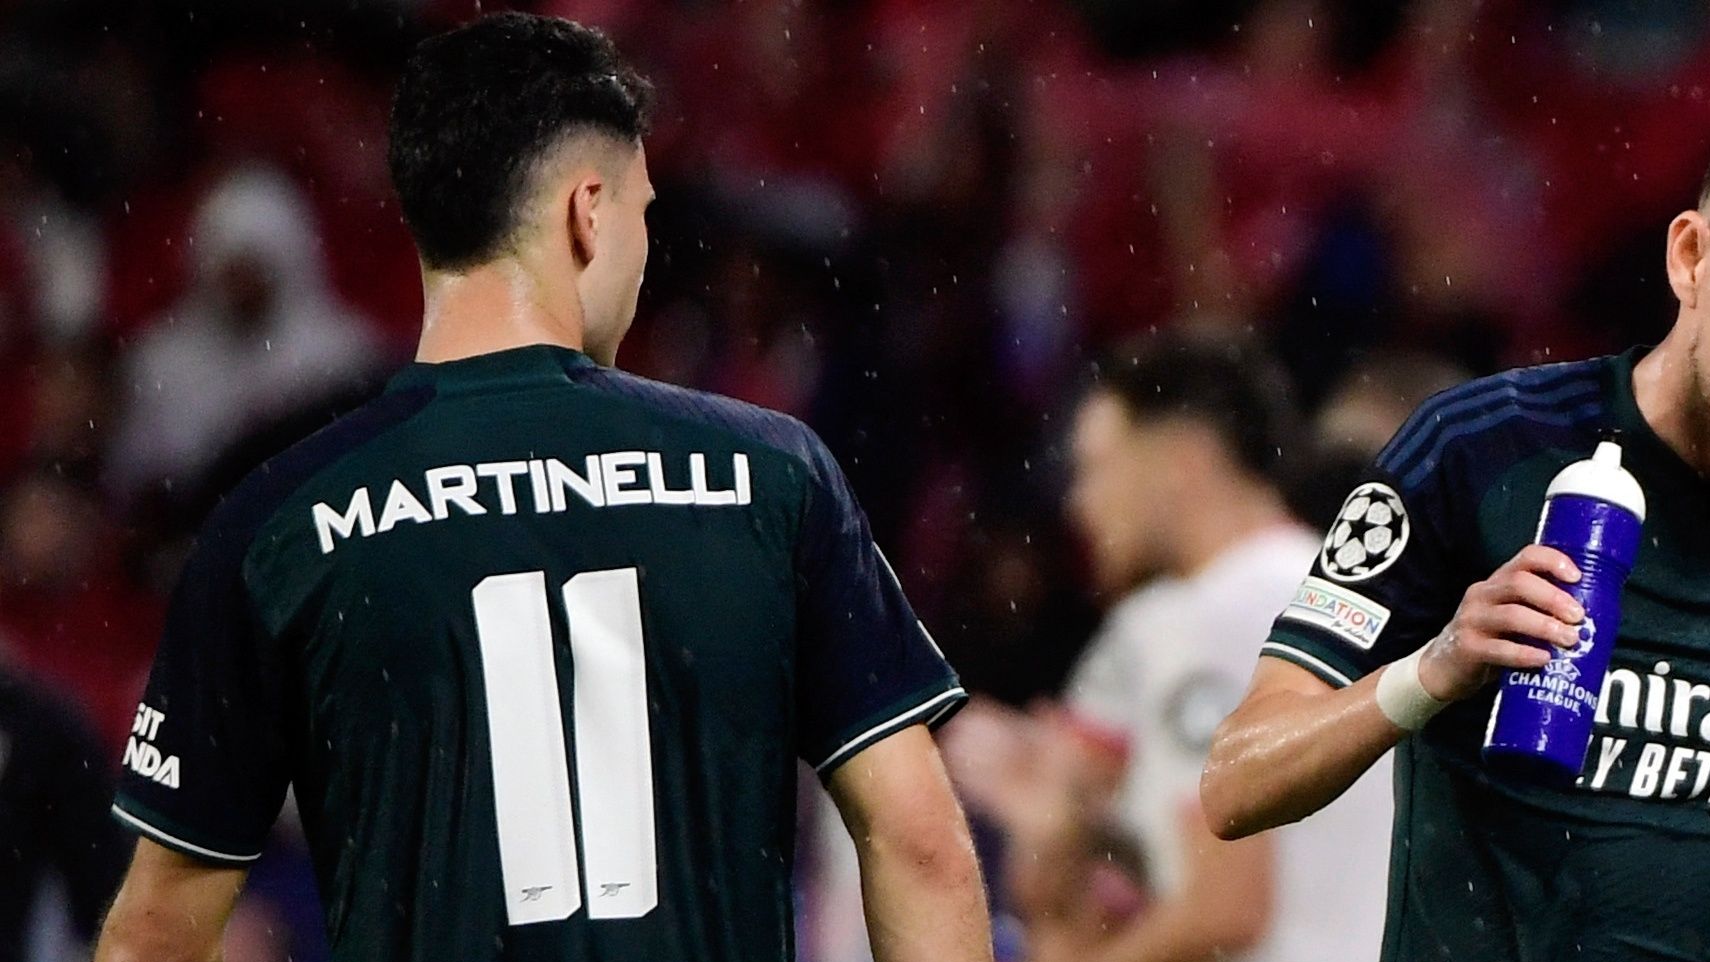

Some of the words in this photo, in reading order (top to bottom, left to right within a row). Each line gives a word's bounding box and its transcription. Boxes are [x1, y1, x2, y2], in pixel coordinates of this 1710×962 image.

[312, 451, 751, 553] MARTINELLI
[1508, 671, 1599, 711] CHAMPIONS
[1527, 687, 1582, 714] LEAGUE
[473, 568, 658, 925] 11
